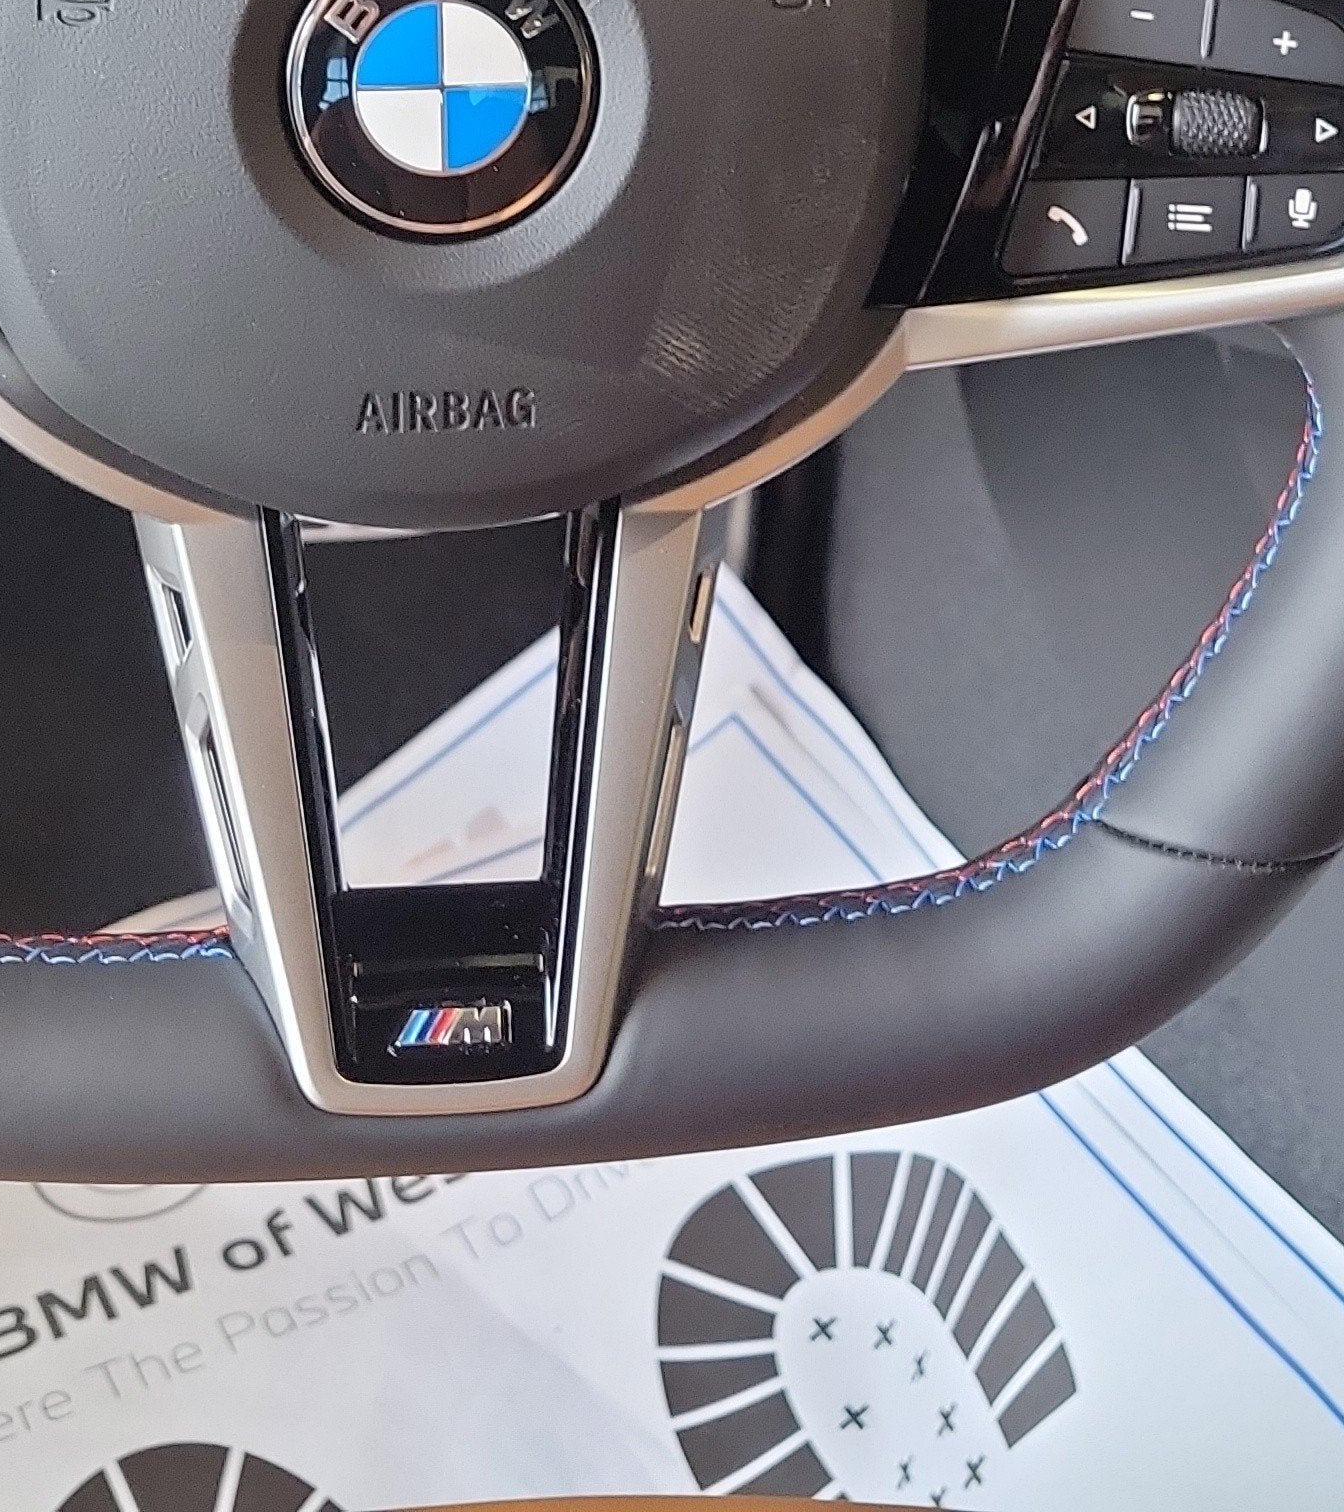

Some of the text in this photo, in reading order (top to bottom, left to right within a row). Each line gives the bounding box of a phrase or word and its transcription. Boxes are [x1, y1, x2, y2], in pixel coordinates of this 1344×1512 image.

[355, 387, 536, 435] AIRBAG
[222, 1206, 294, 1272] of
[304, 1172, 467, 1237] We
[84, 1340, 204, 1400] The
[215, 1252, 441, 1355] Passion
[439, 1210, 524, 1259] To
[527, 1162, 656, 1224] Driv
